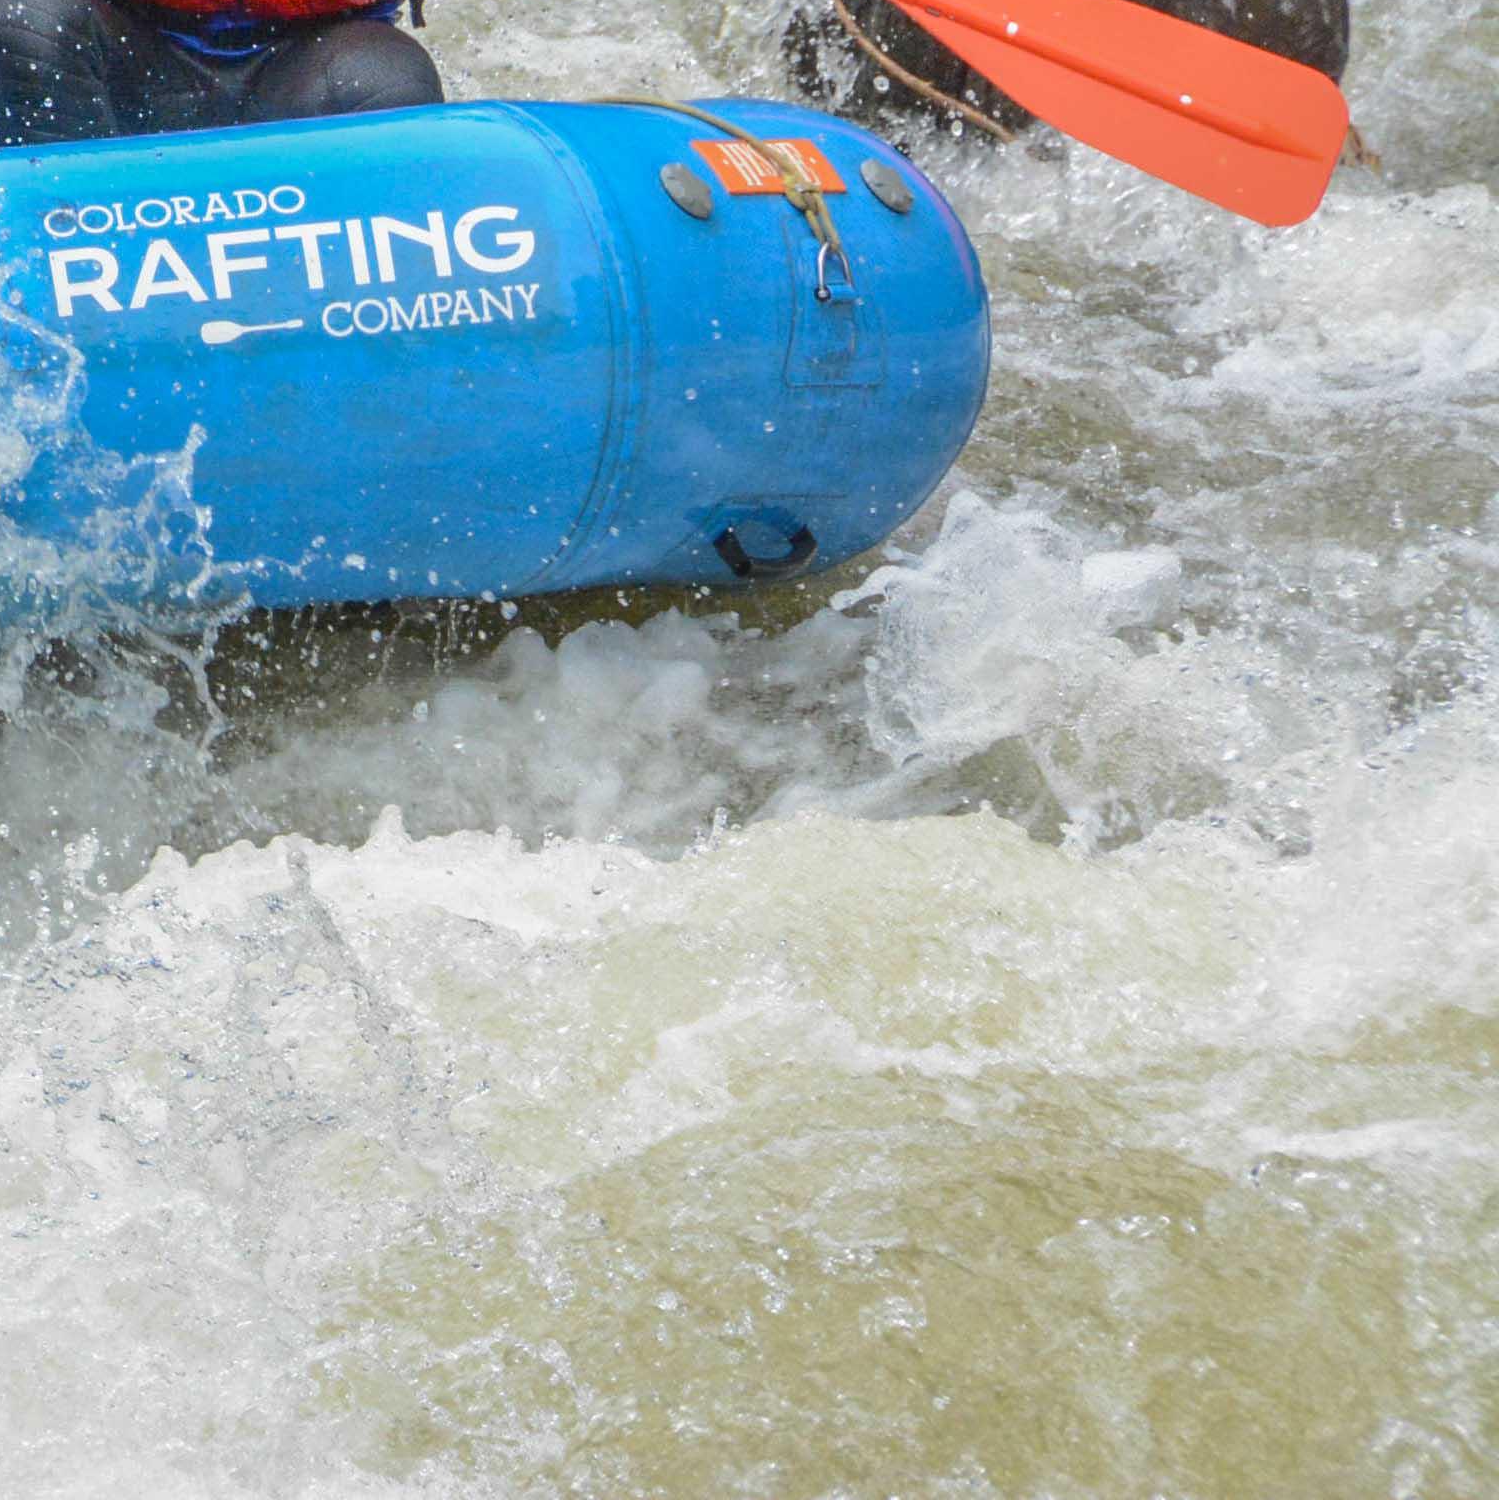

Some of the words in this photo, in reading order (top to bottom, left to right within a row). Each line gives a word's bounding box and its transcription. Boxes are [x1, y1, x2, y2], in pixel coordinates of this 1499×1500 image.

[43, 185, 306, 238] COLORADO
[48, 205, 535, 317] RAFTING
[322, 284, 540, 338] COMPANY
